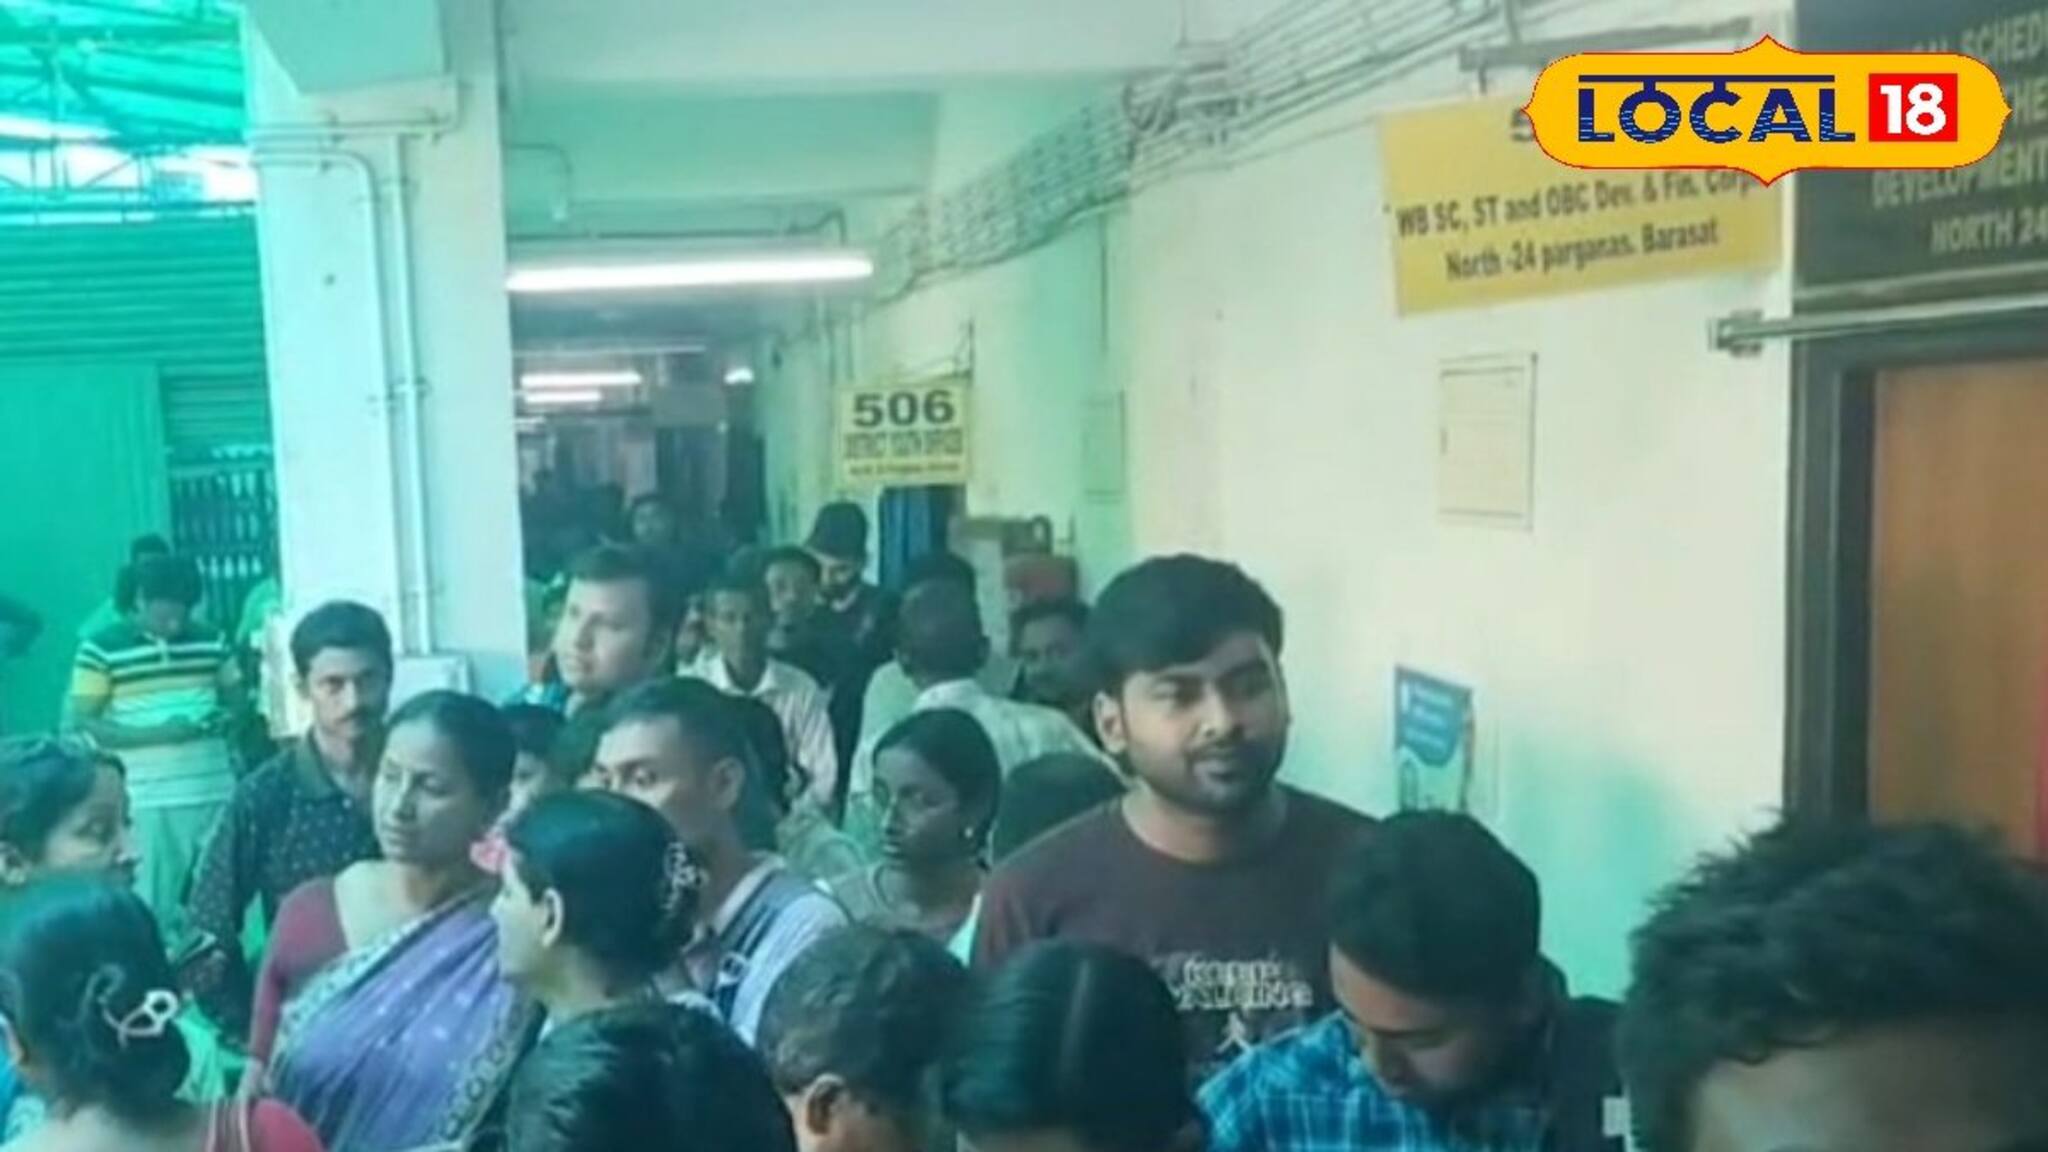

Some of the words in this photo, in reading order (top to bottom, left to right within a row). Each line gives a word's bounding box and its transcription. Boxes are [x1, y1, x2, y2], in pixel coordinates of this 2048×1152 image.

[1397, 205, 1429, 237] WB
[1475, 196, 1498, 227] ST
[1505, 190, 1540, 220] and
[1546, 183, 1590, 216] OBC
[1646, 175, 1658, 202] &
[1930, 206, 2014, 254] NORTH
[1447, 248, 1501, 281] North
[1642, 218, 1719, 254] Barasat
[854, 391, 955, 428] 506
